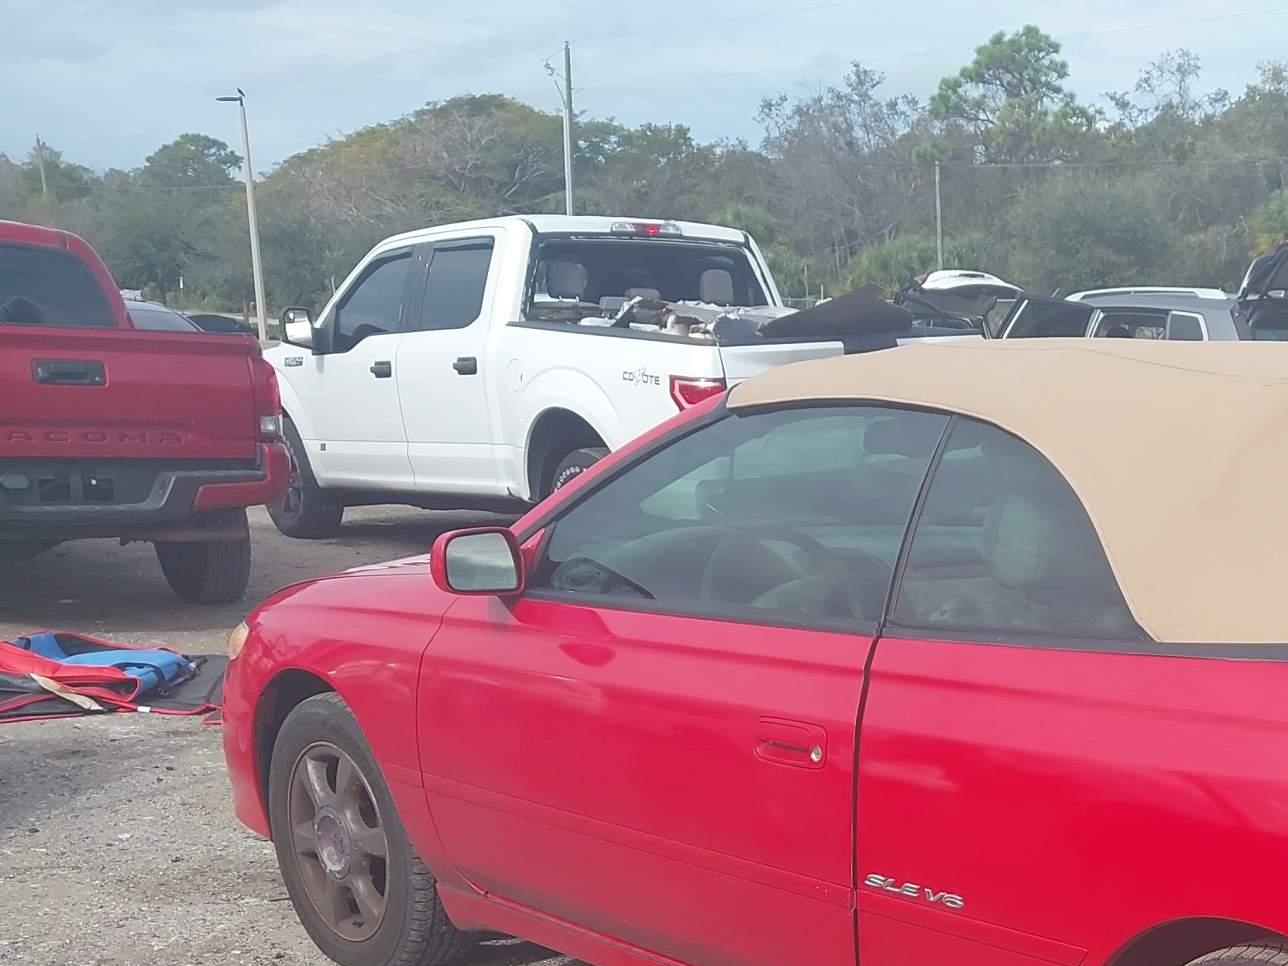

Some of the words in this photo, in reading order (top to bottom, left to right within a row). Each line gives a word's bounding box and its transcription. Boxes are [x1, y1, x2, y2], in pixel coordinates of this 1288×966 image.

[7, 431, 184, 443] ACOMA
[864, 873, 921, 897] SLE
[924, 887, 965, 909] V6
